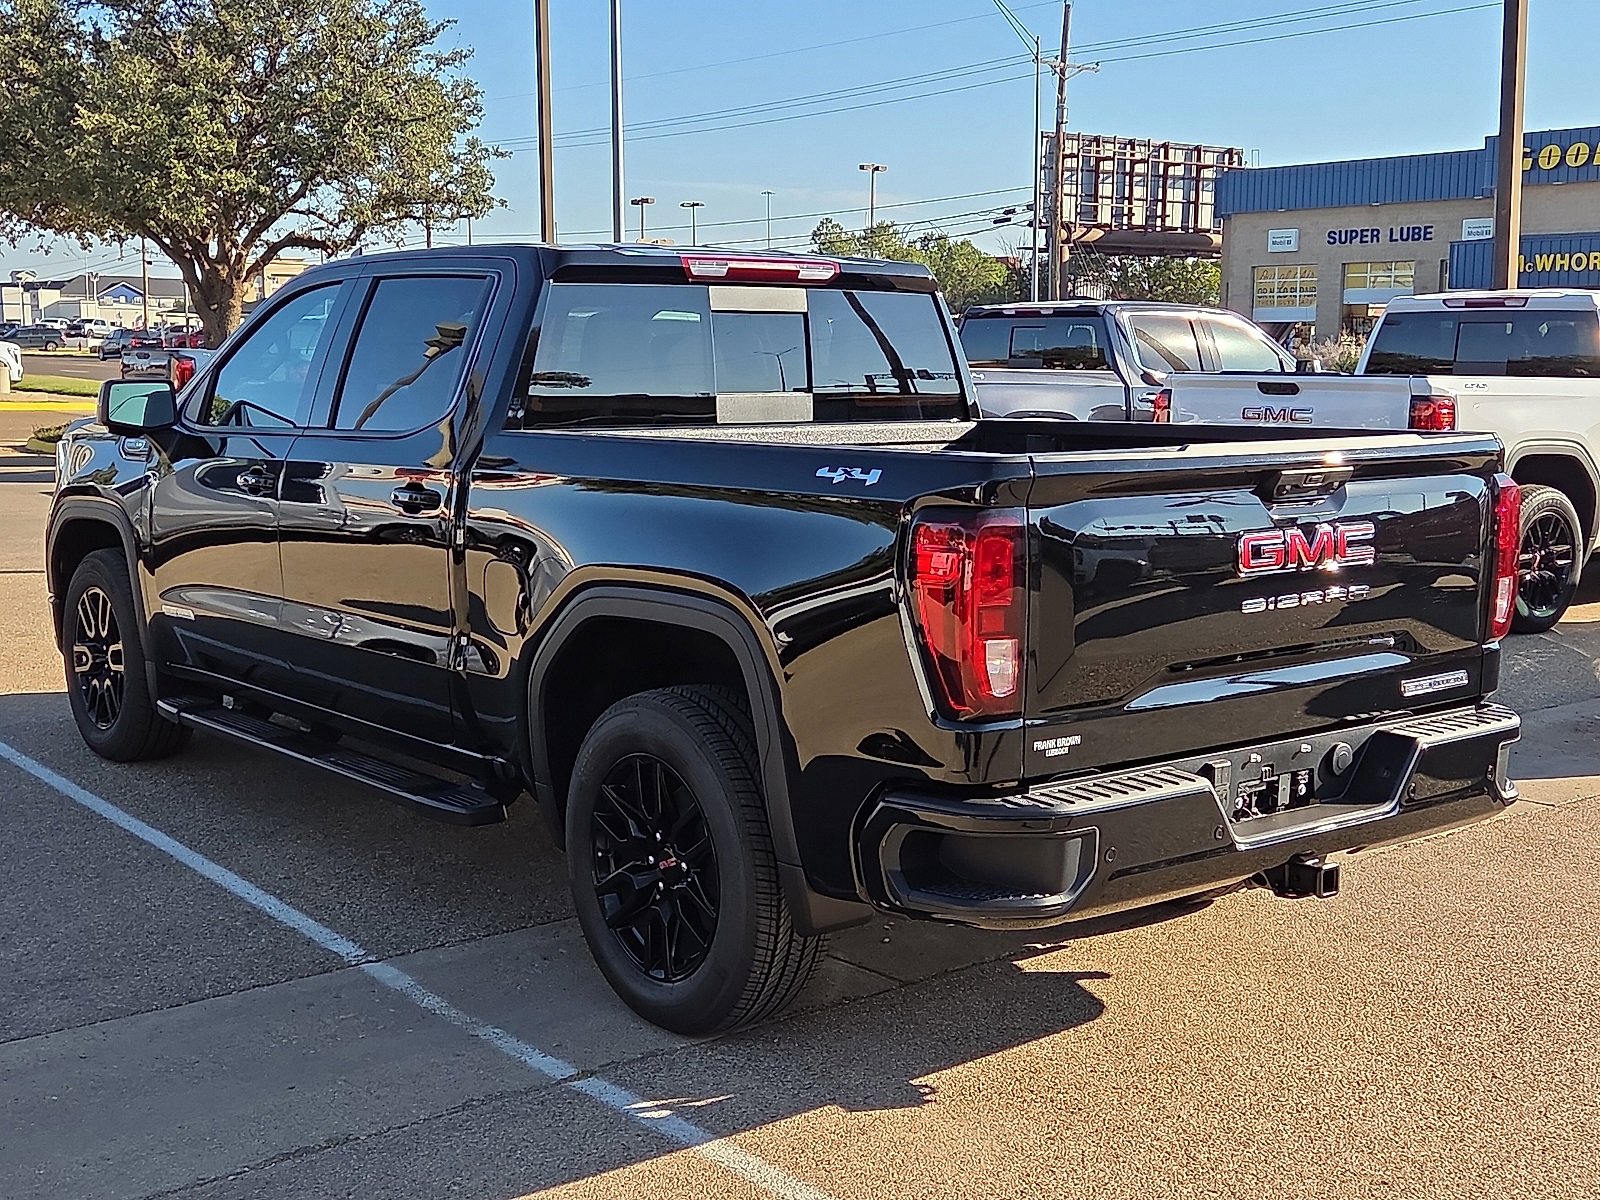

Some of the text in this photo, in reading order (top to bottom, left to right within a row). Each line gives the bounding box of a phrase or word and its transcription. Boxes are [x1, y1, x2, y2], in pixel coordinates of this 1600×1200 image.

[1326, 225, 1435, 246] SUPER LUBE
[1241, 405, 1314, 424] GMC
[1236, 521, 1376, 577] GMC
[1033, 734, 1082, 752] FRANK BROWN
